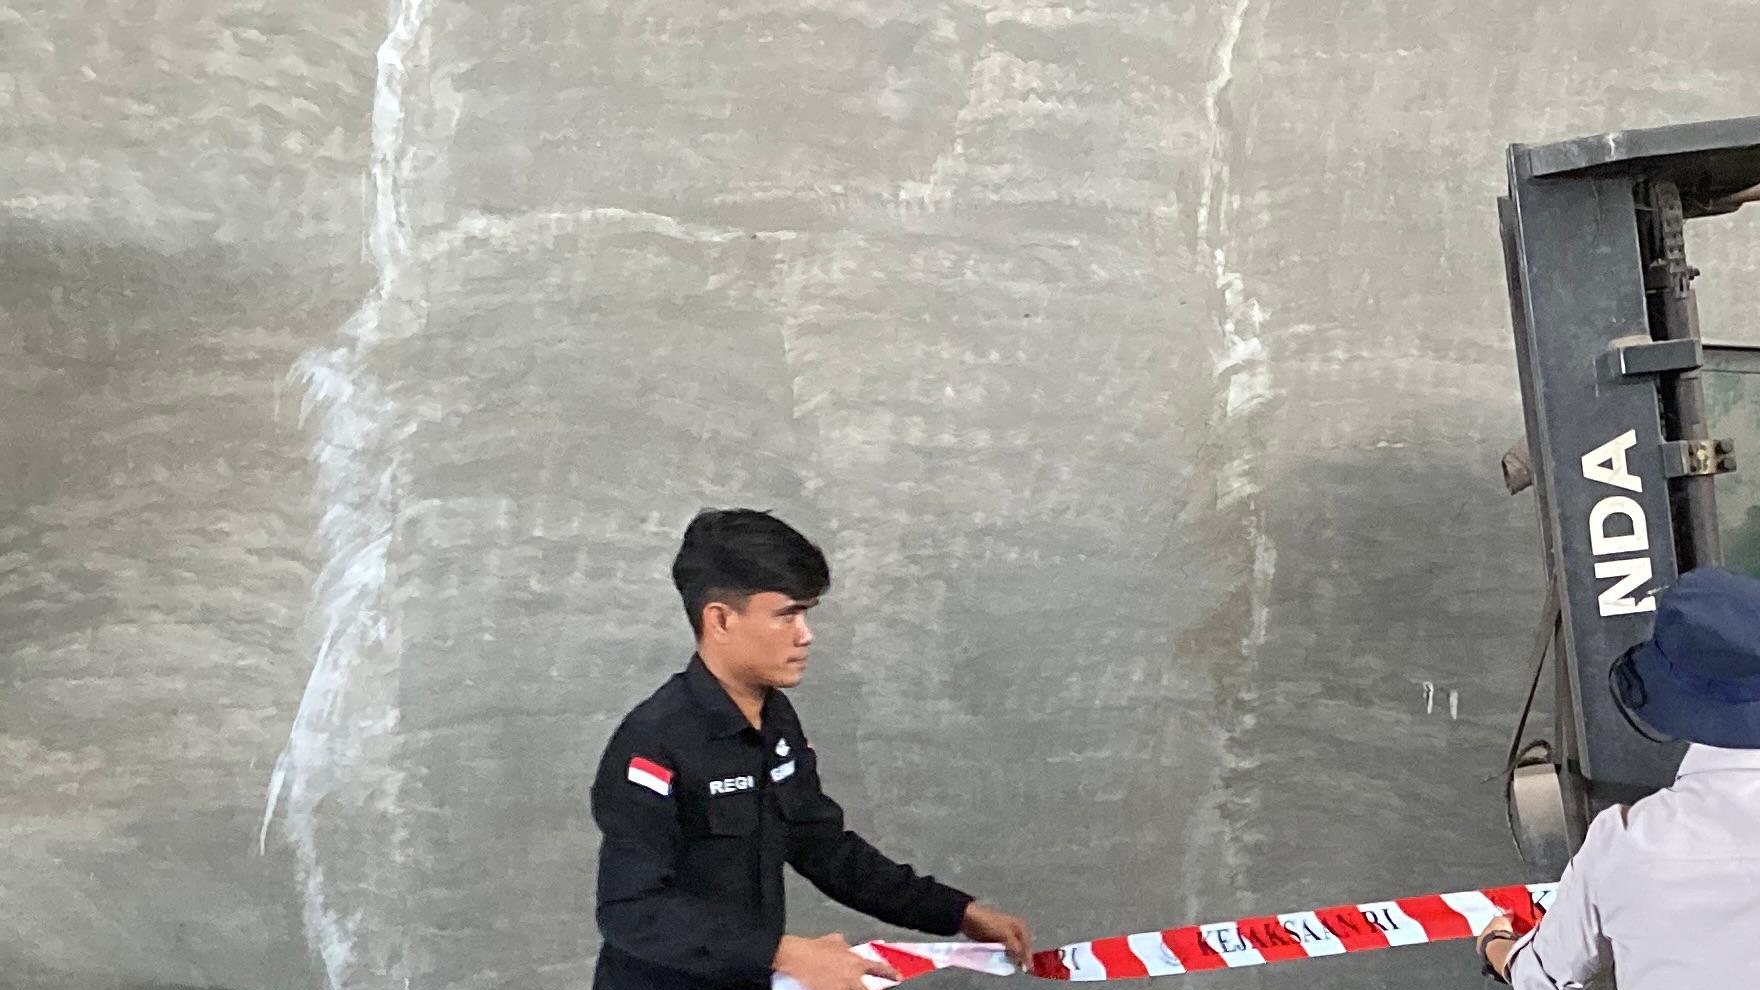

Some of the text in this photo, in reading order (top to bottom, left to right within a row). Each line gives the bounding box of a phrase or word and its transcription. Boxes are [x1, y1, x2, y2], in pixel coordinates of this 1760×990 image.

[1581, 428, 1657, 617] NDA
[1196, 908, 1400, 956] KEJAKSAAN RI
